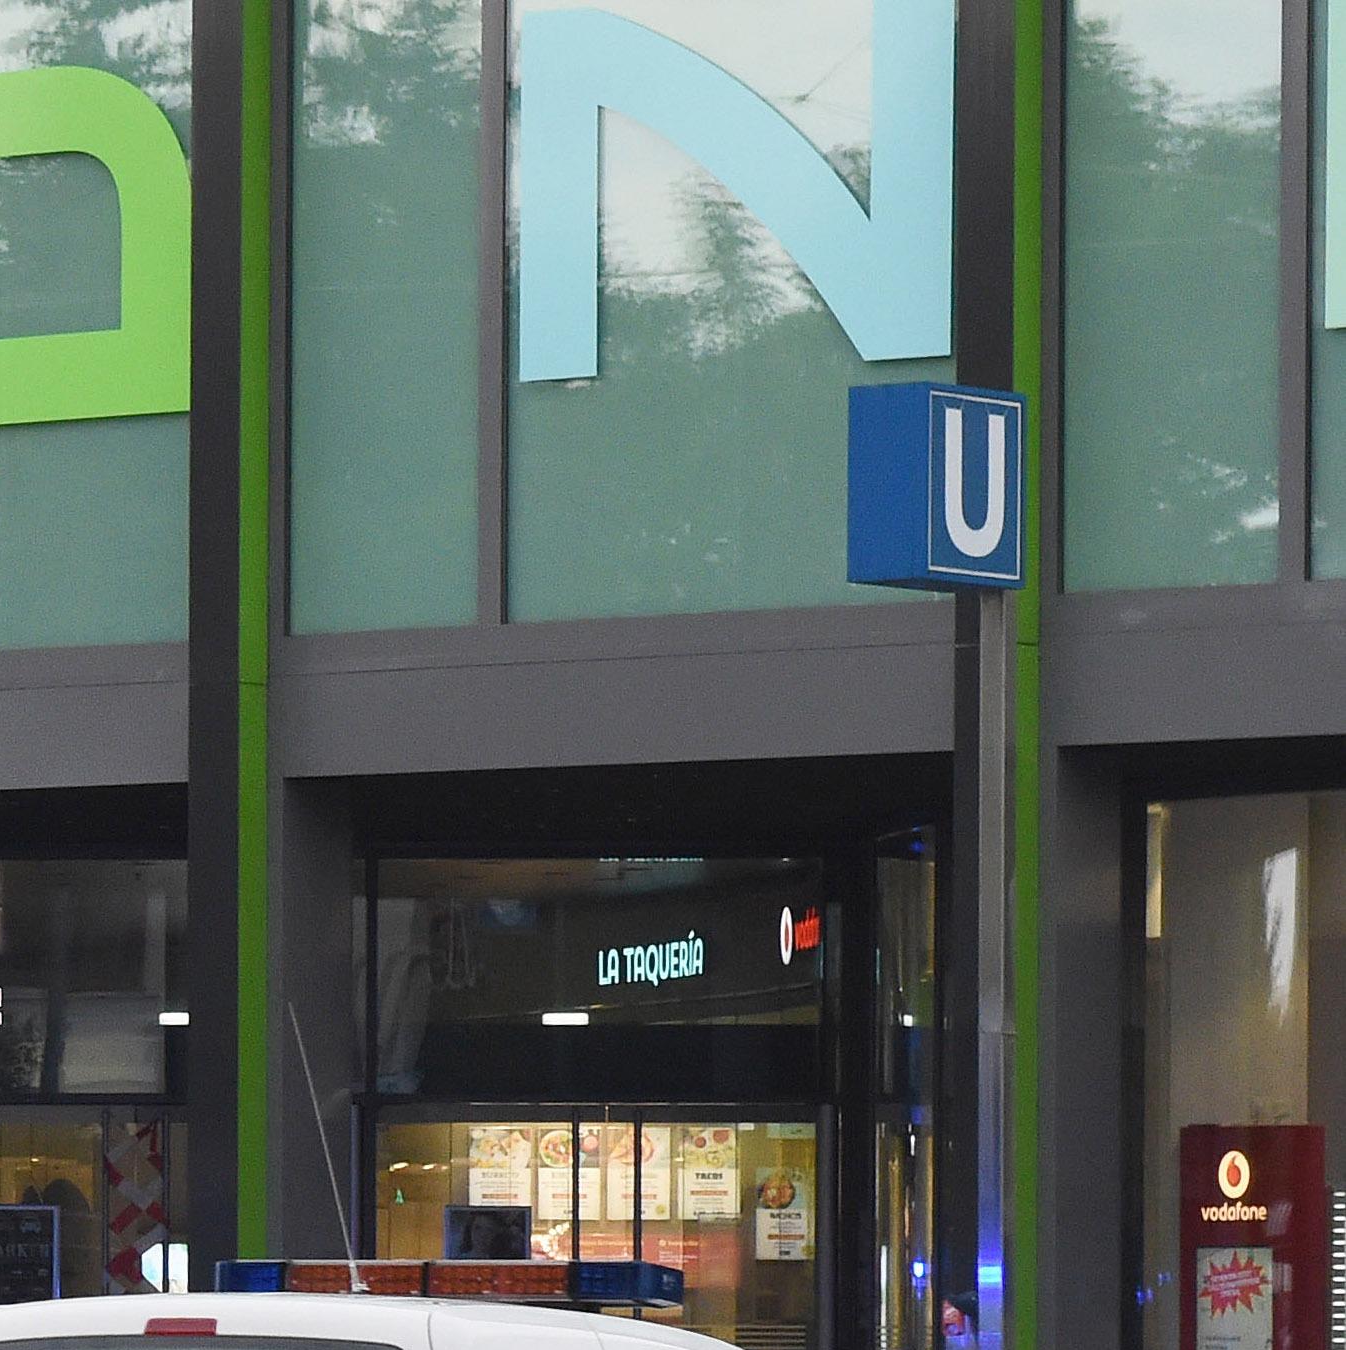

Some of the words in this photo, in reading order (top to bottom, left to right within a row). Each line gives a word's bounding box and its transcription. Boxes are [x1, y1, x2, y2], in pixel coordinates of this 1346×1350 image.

[945, 407, 1006, 557] U
[598, 948, 620, 986] LA
[622, 929, 704, 987] TAQUERÍA
[1201, 1201, 1268, 1222] vodafone
